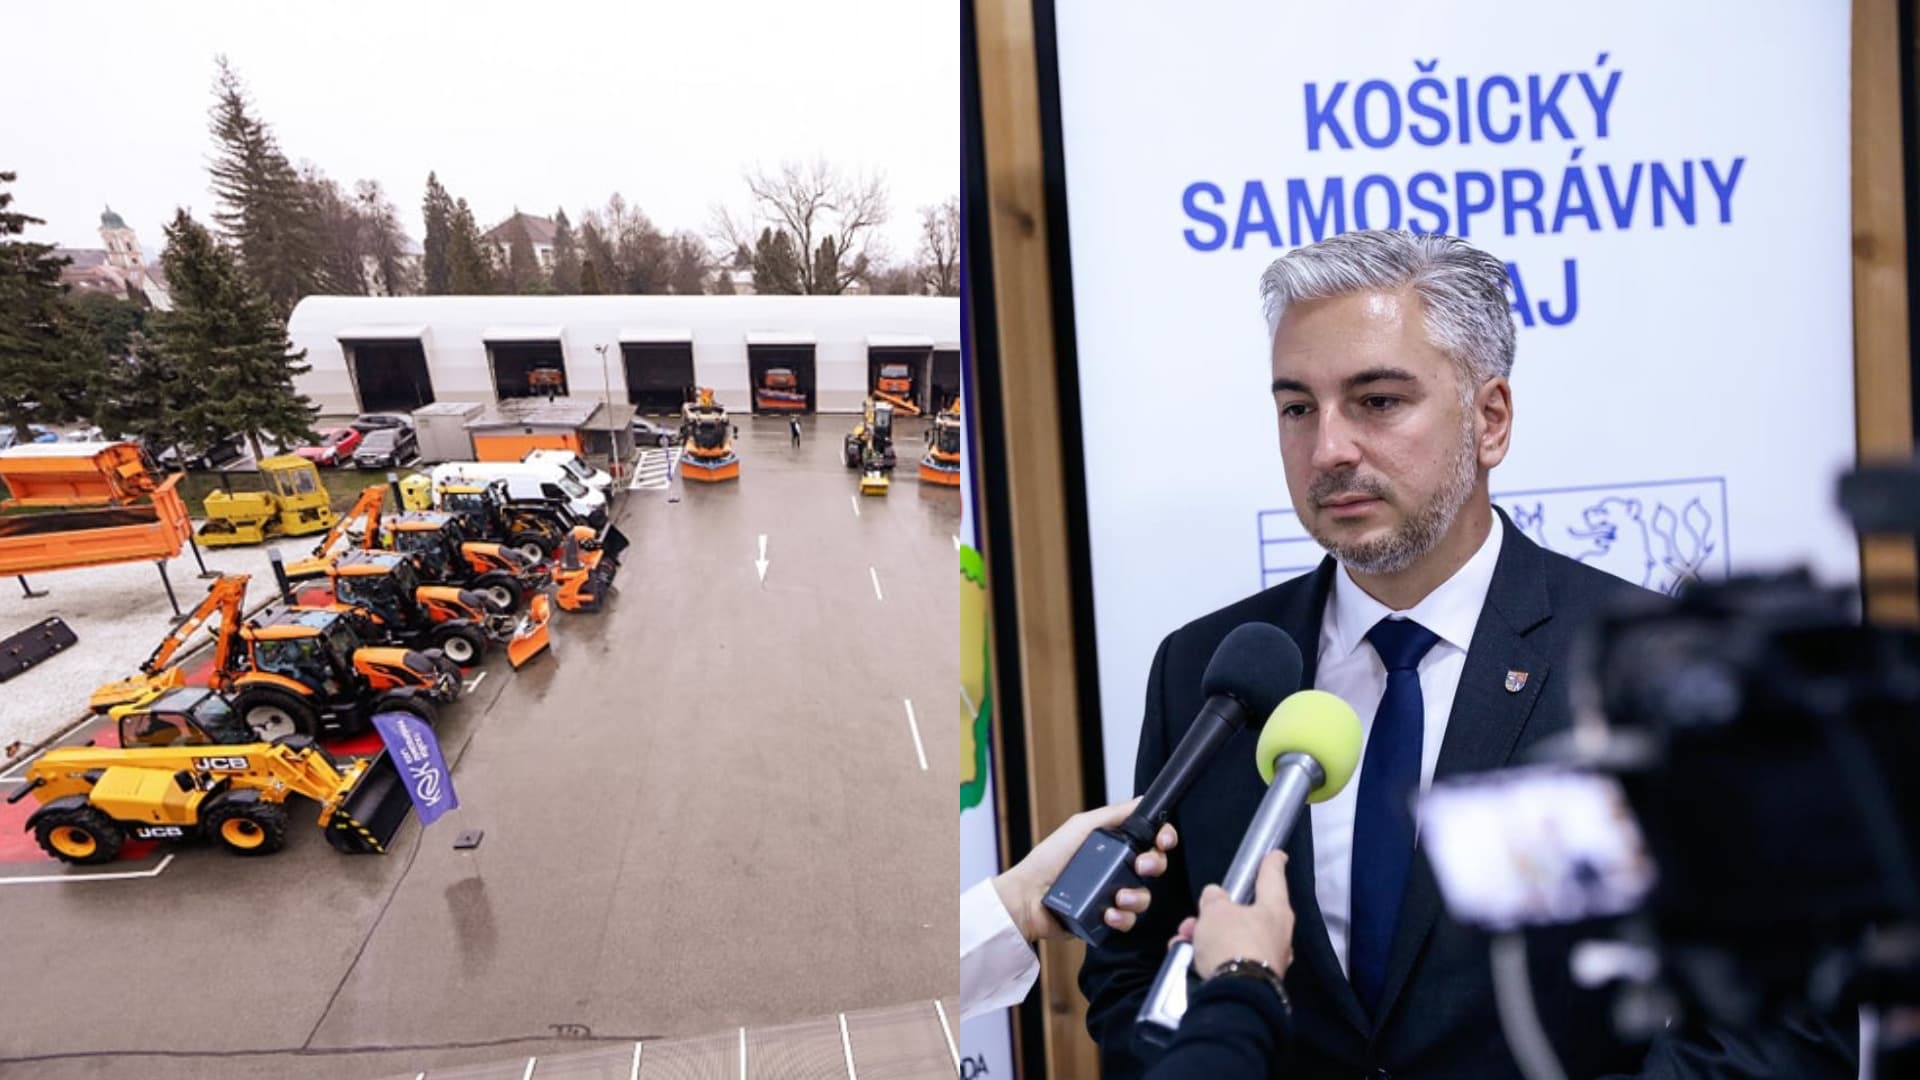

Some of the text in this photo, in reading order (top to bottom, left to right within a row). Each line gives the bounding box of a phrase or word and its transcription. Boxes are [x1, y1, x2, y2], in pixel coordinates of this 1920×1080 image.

[1304, 52, 1623, 151] KOŠICKÝ
[1181, 147, 1746, 252] SAMOSPRÁVNY
[1504, 258, 1579, 327] AJ
[195, 756, 249, 770] JCB
[138, 826, 184, 838] JCB
